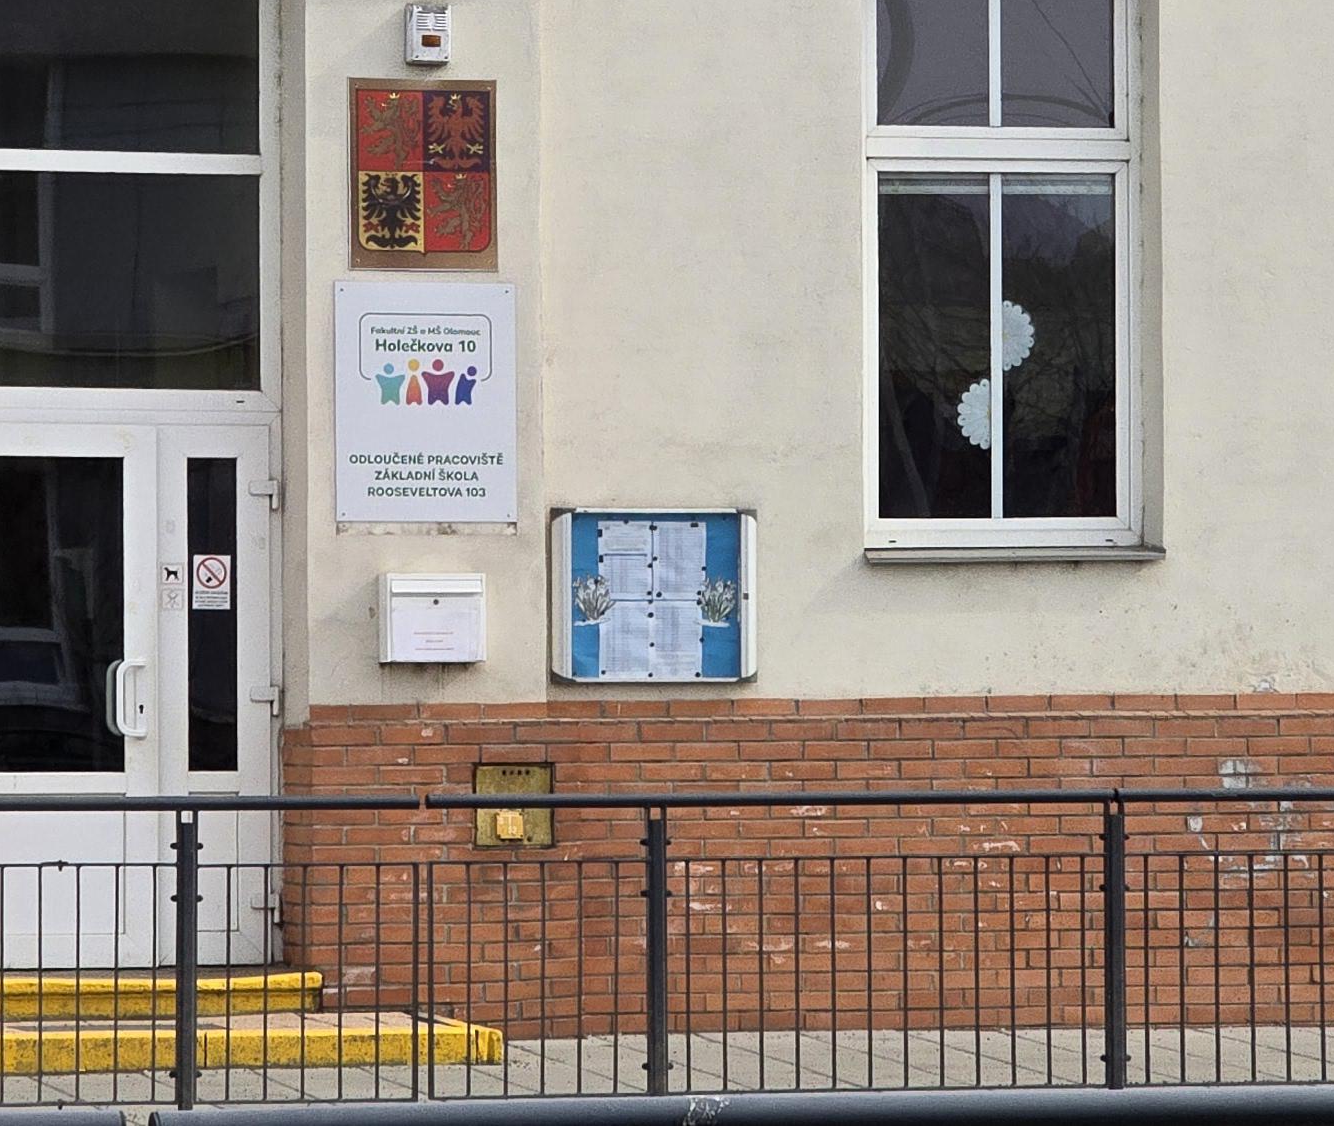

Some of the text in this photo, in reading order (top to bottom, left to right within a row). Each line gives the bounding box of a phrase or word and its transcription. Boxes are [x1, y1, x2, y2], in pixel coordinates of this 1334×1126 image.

[370, 325, 405, 335] Fakultní
[407, 325, 418, 335] ZŠ
[427, 325, 441, 335] MŠ
[443, 327, 481, 336] Olomouc
[375, 338, 477, 353] Holečkova 10
[349, 451, 504, 465] ODLOUČENÉ PRACOVIŠTĚ
[374, 468, 479, 481] ZÁKLADNÍ ŠKOLA
[367, 487, 486, 497] ROOSEVELTOVA 103
